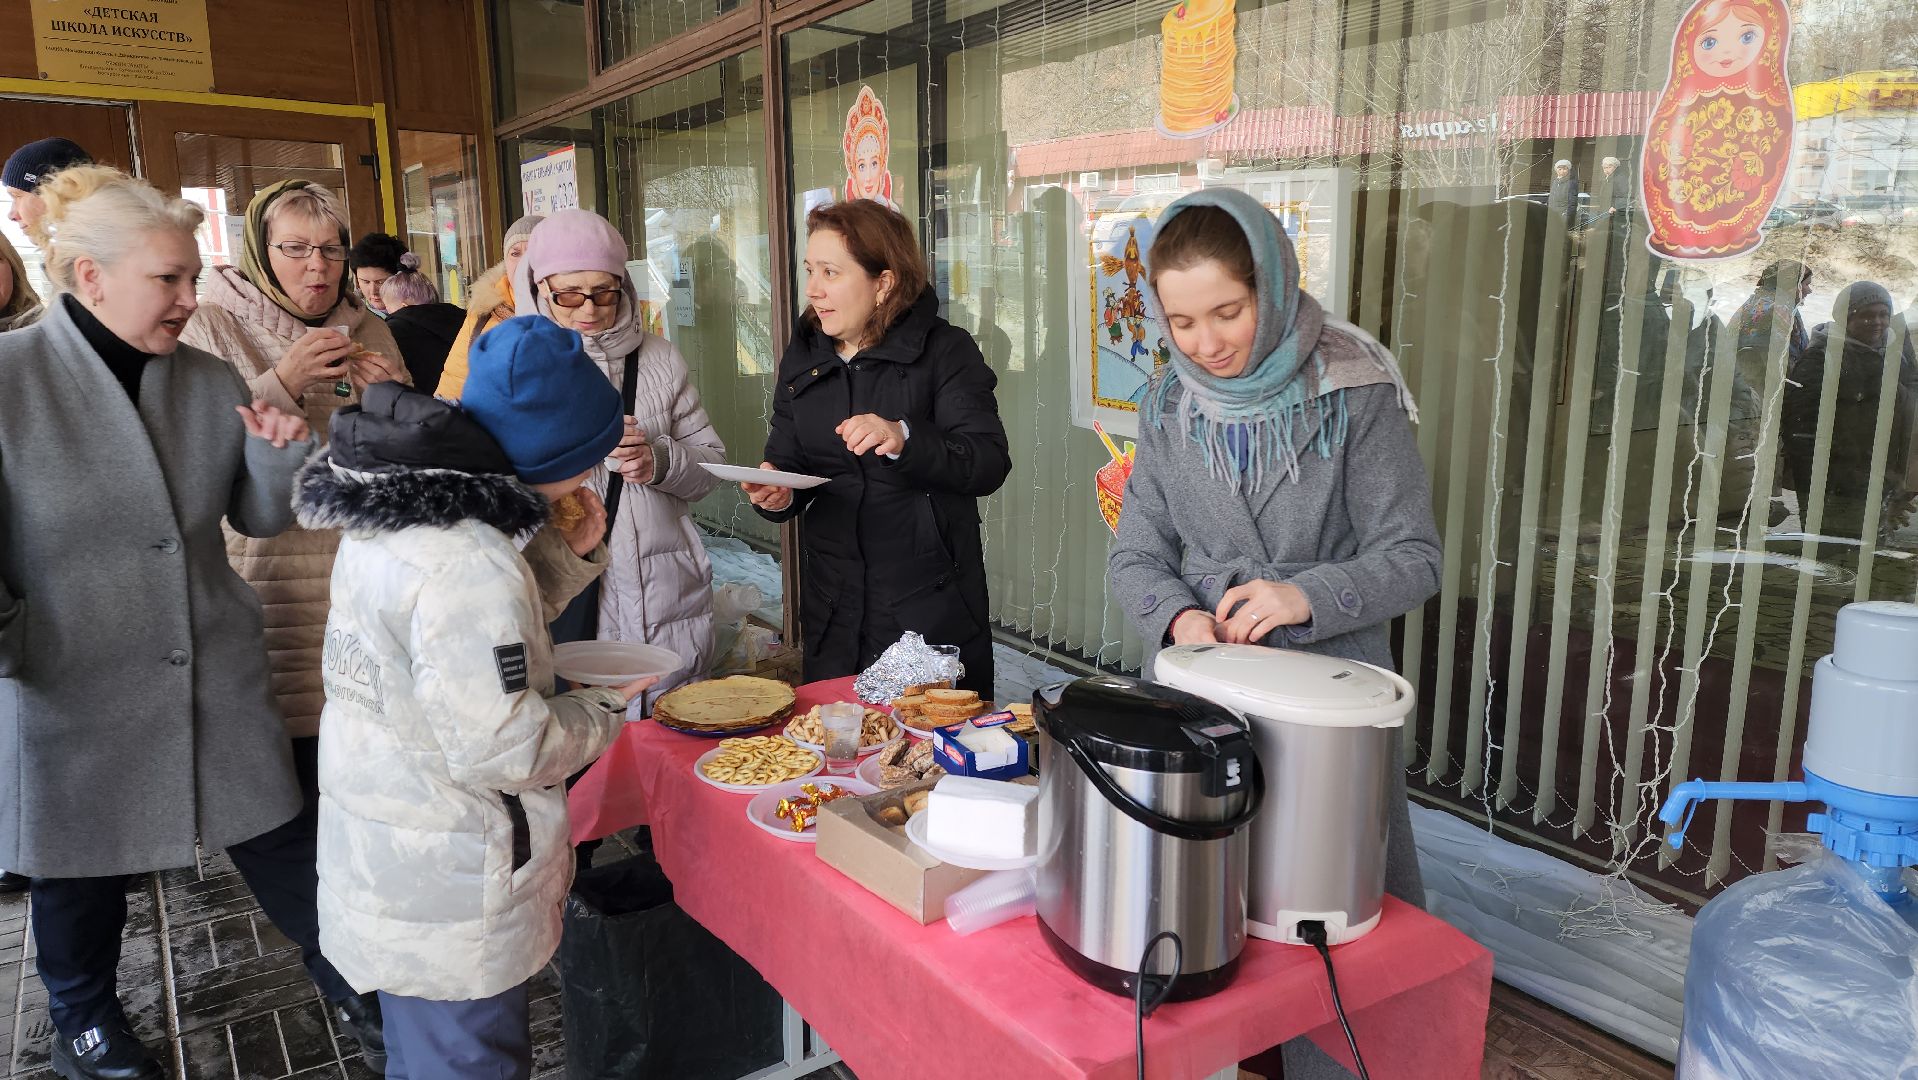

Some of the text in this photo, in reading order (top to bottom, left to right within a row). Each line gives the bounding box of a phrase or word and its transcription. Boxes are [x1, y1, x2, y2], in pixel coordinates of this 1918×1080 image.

[83, 6, 159, 24] «ДЕТСКАЯ
[51, 19, 193, 43] ШКОЛА ИСКУССТВ»
